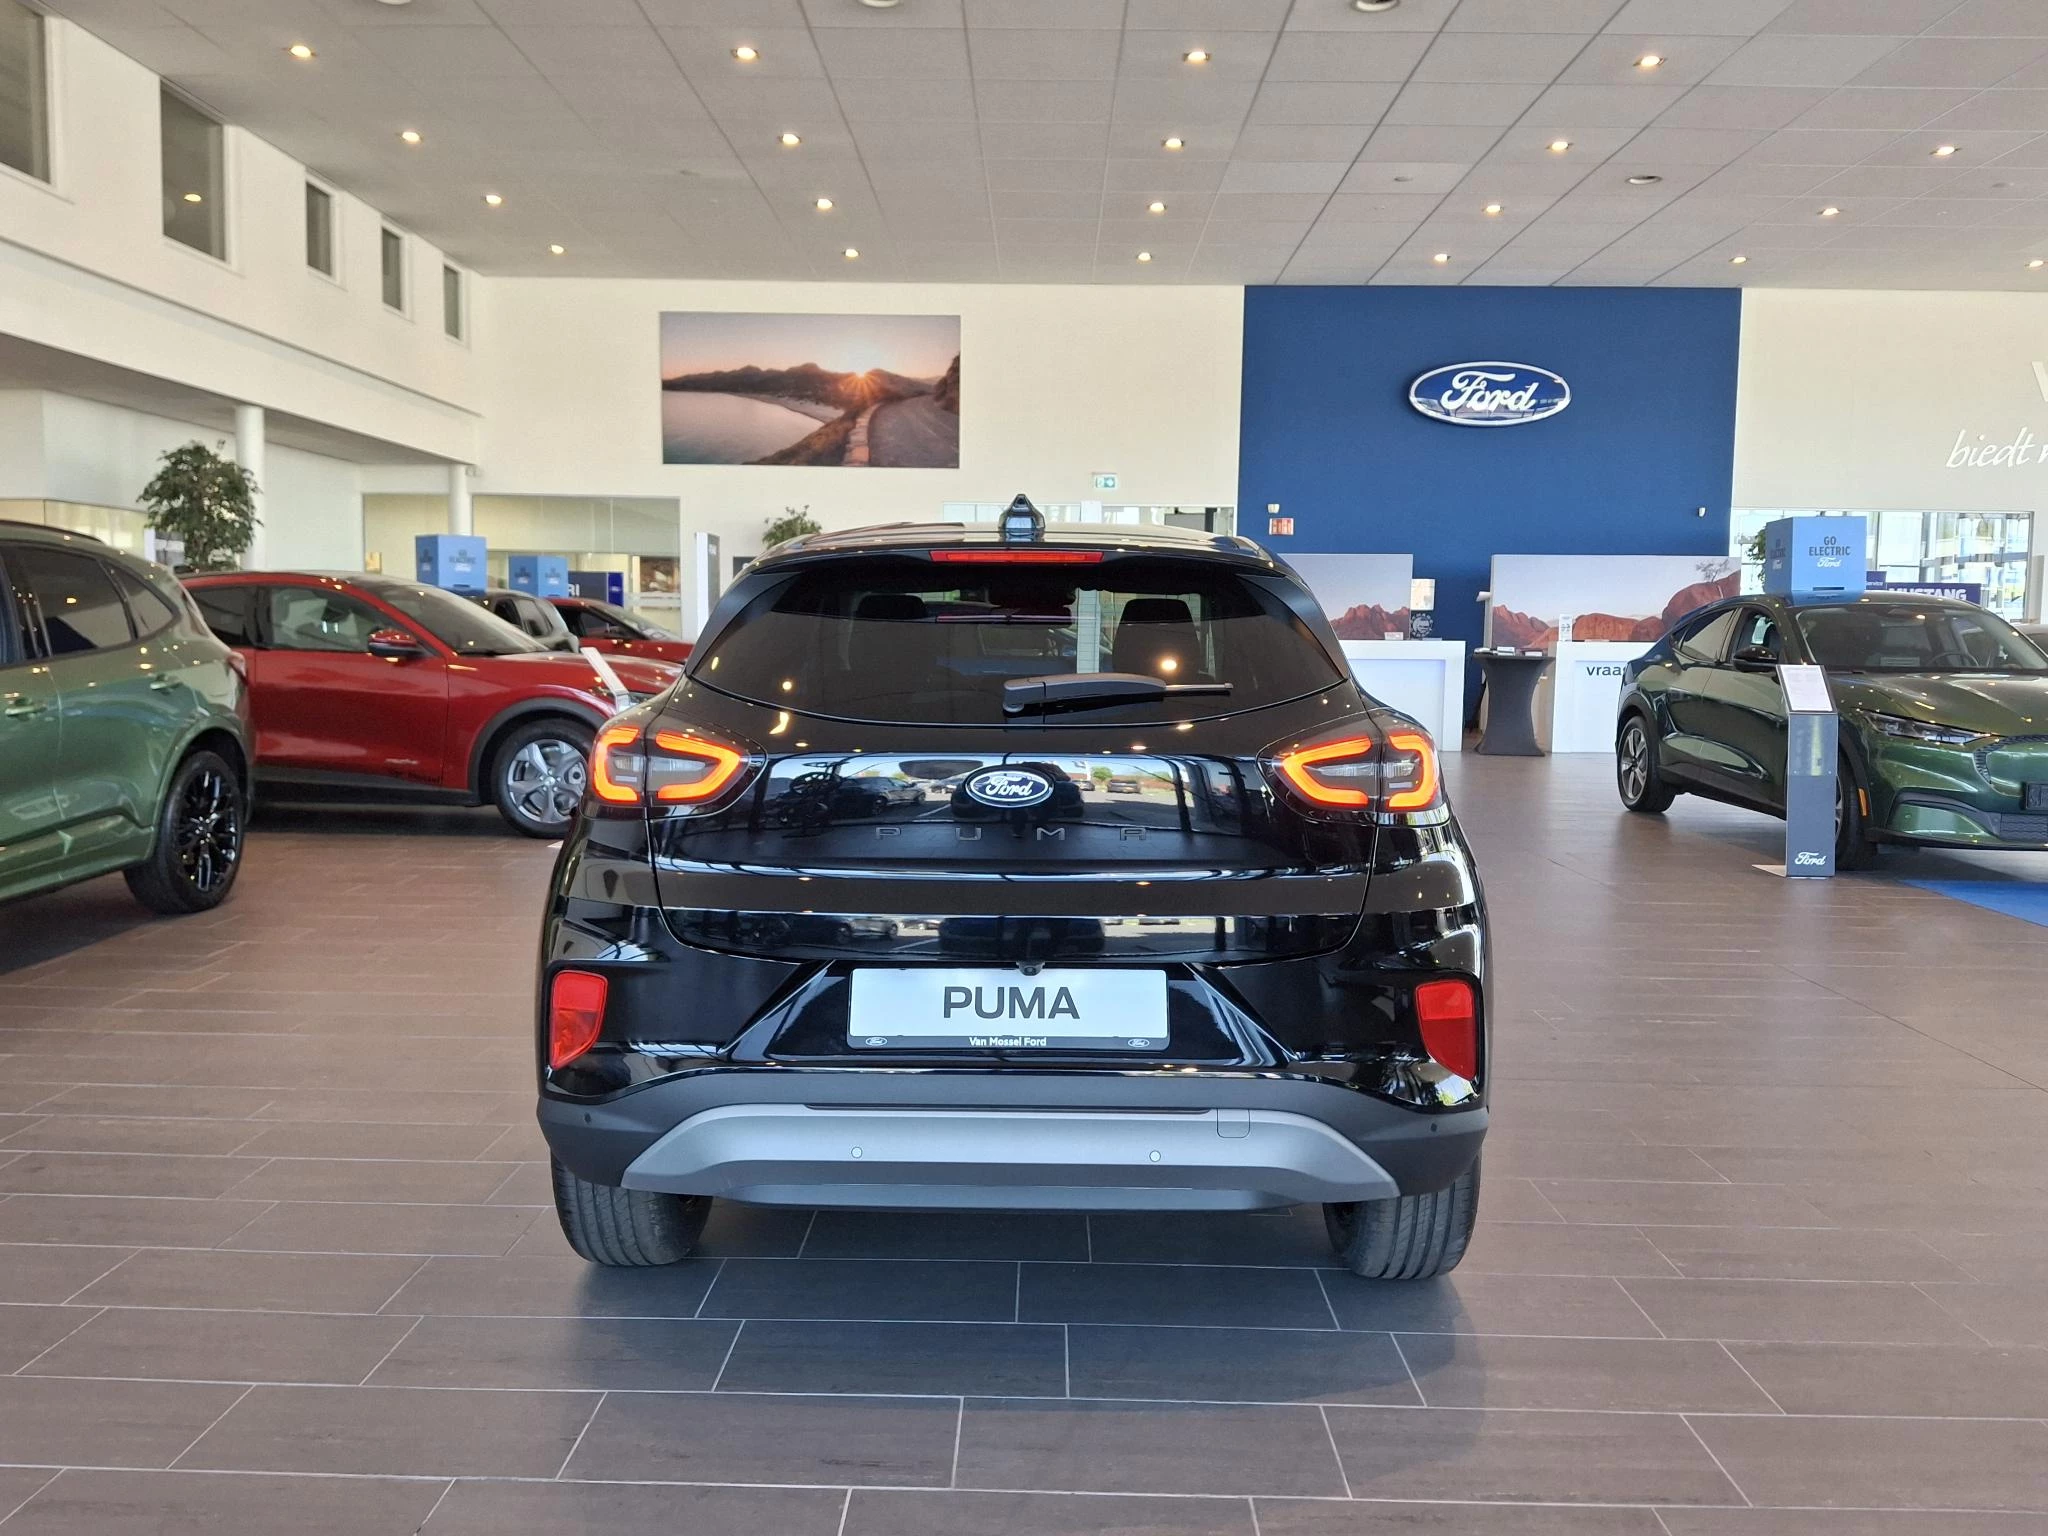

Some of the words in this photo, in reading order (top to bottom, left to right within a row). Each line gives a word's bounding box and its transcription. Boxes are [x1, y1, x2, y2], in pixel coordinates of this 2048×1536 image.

[1441, 370, 1540, 415] Ford
[1945, 426, 2035, 468] biedt
[1823, 536, 1837, 546] GO
[1808, 546, 1851, 556] ELECTRIC
[1816, 556, 1842, 568] Ford
[1586, 666, 1625, 676] vraa
[985, 774, 1034, 798] Ford
[875, 826, 1147, 842] PUMA
[1794, 851, 1827, 866] Ford
[943, 985, 1081, 1020] PUMA
[969, 1037, 988, 1046] Van
[989, 1037, 1022, 1046] Mossel
[1024, 1037, 1047, 1047] Ford
